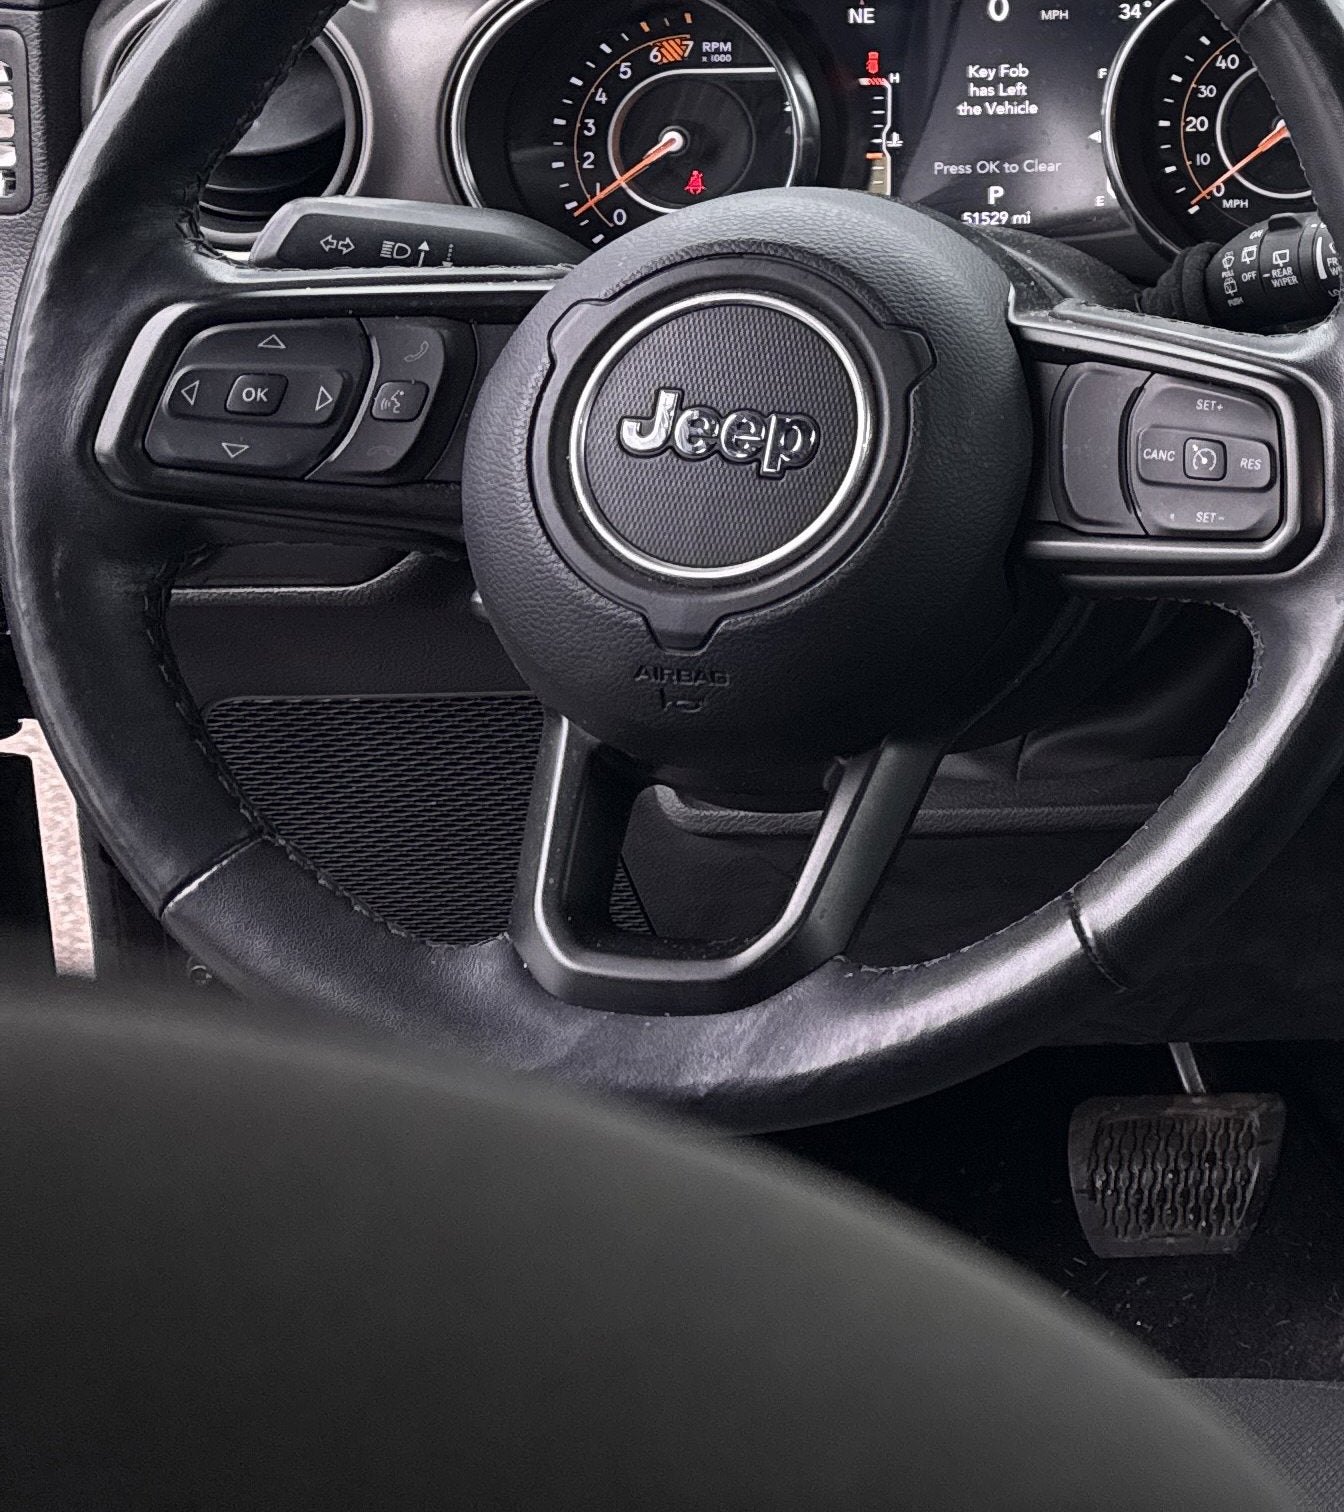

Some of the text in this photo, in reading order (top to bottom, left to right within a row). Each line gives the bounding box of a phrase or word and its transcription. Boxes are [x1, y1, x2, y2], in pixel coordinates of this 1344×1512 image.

[848, 7, 876, 25] NE
[1040, 9, 1069, 21] MPH
[649, 46, 662, 64] 6
[683, 41, 695, 59] 7
[702, 42, 733, 54] RPM
[1216, 55, 1240, 71] 40
[619, 63, 632, 80] 5
[889, 73, 901, 84] H
[968, 64, 1030, 81] Key Fob
[1098, 67, 1108, 79] F
[595, 89, 608, 105] 4
[969, 82, 1028, 98] has Left
[1198, 84, 1218, 100] 30
[956, 100, 1039, 117] the Vehicle
[583, 119, 596, 136] 3
[1185, 117, 1210, 133] 20
[582, 152, 595, 169] 2
[933, 158, 1062, 175] Press OK to Clear
[1194, 153, 1211, 167] 10
[987, 186, 1004, 205] P
[1095, 196, 1106, 207] E
[1222, 197, 1250, 210] MPH
[613, 209, 627, 227] 0
[961, 209, 1031, 226] 51529 mi
[1241, 271, 1257, 283] OFF
[1271, 266, 1293, 279] REAR
[1271, 275, 1299, 288] WIPER
[241, 387, 268, 403] OK
[620, 389, 820, 475] Jeep
[1143, 448, 1175, 462] CANC
[1239, 457, 1262, 470] RES
[634, 664, 730, 688] AIRBAG
